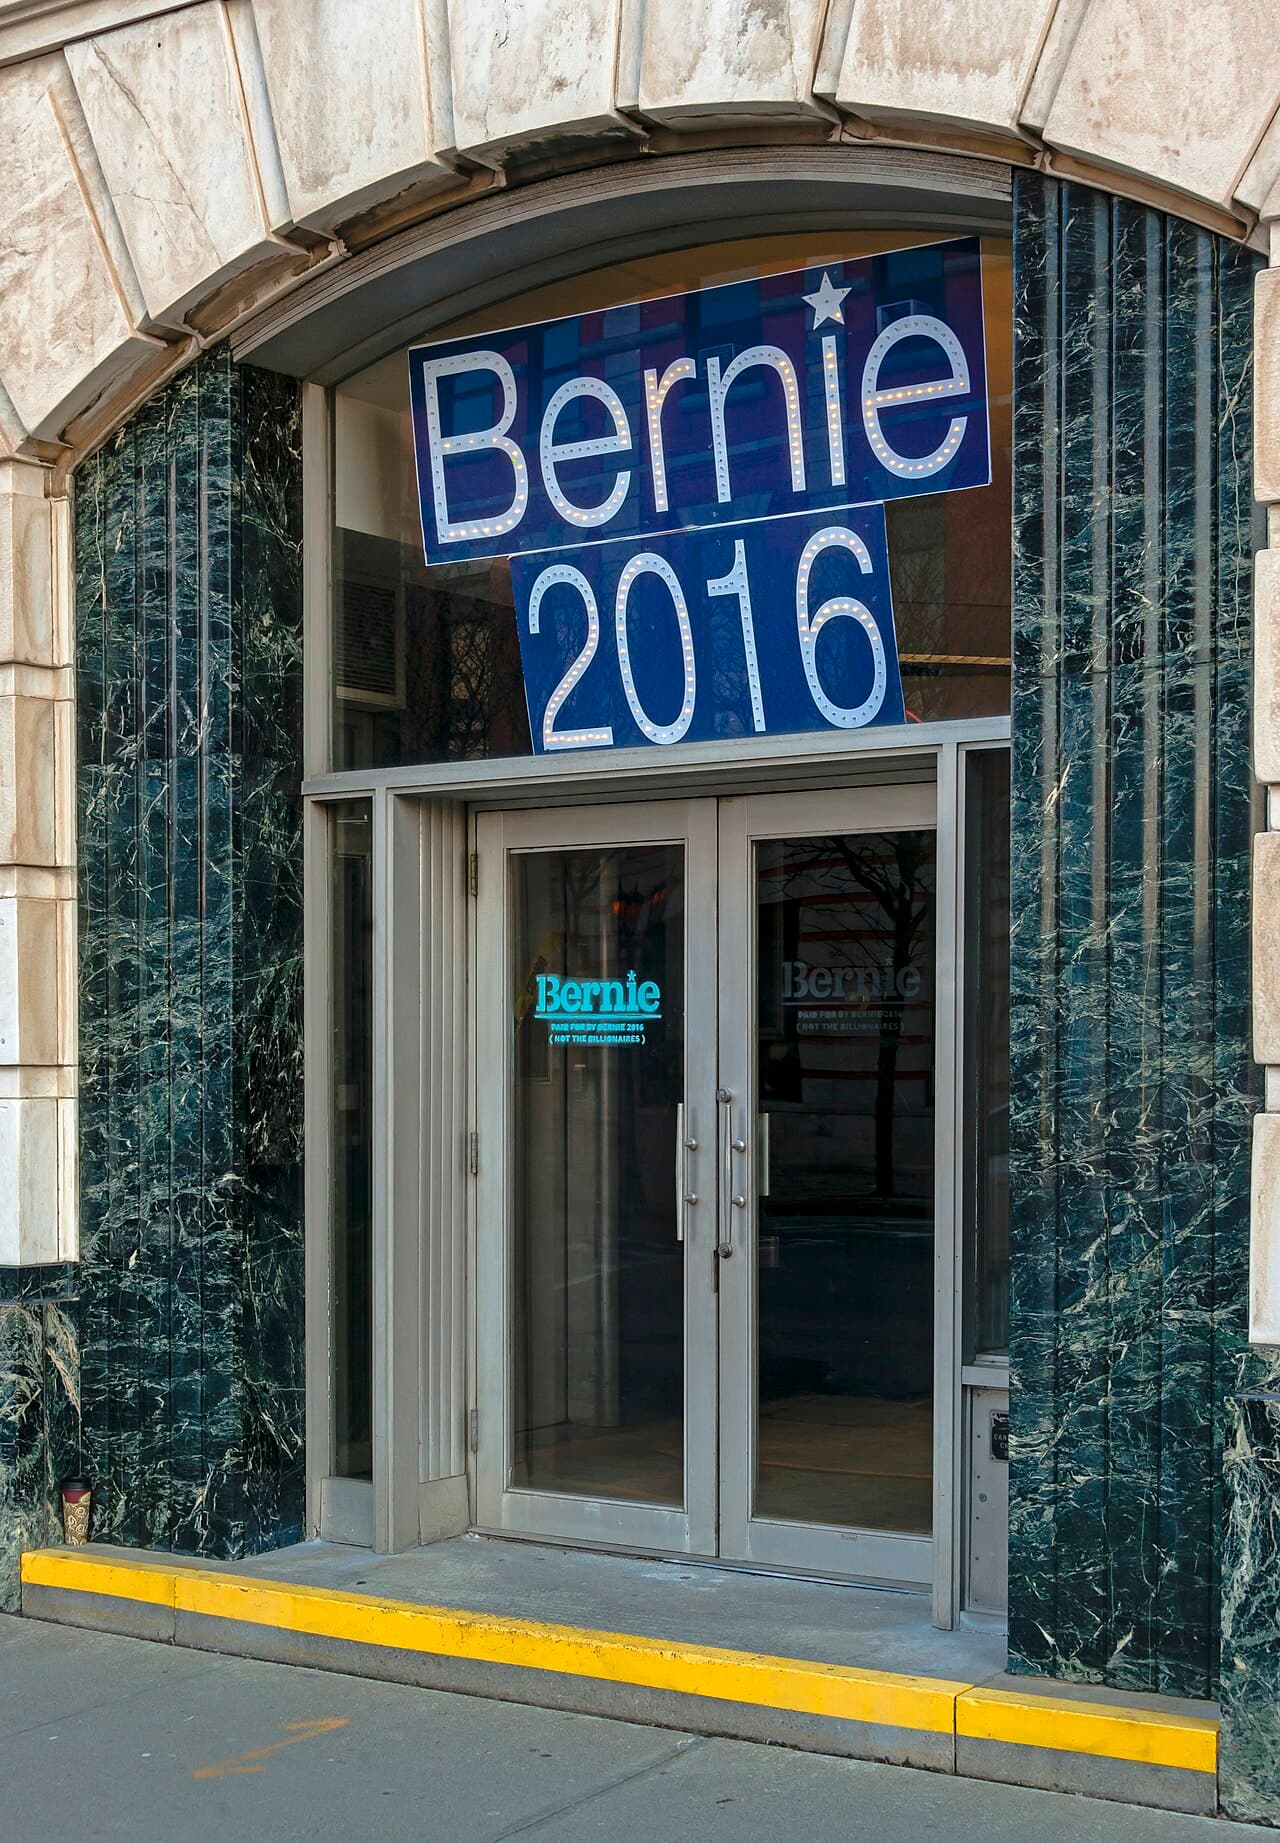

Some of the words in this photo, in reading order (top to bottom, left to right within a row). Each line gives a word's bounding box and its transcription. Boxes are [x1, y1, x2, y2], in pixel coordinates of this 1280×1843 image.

[422, 270, 971, 545] Bernie
[529, 526, 887, 751] 2016
[535, 970, 661, 1013] Bernie
[782, 956, 921, 998] Bernie
[571, 1034, 587, 1043] THE
[626, 1023, 644, 1031] 2016
